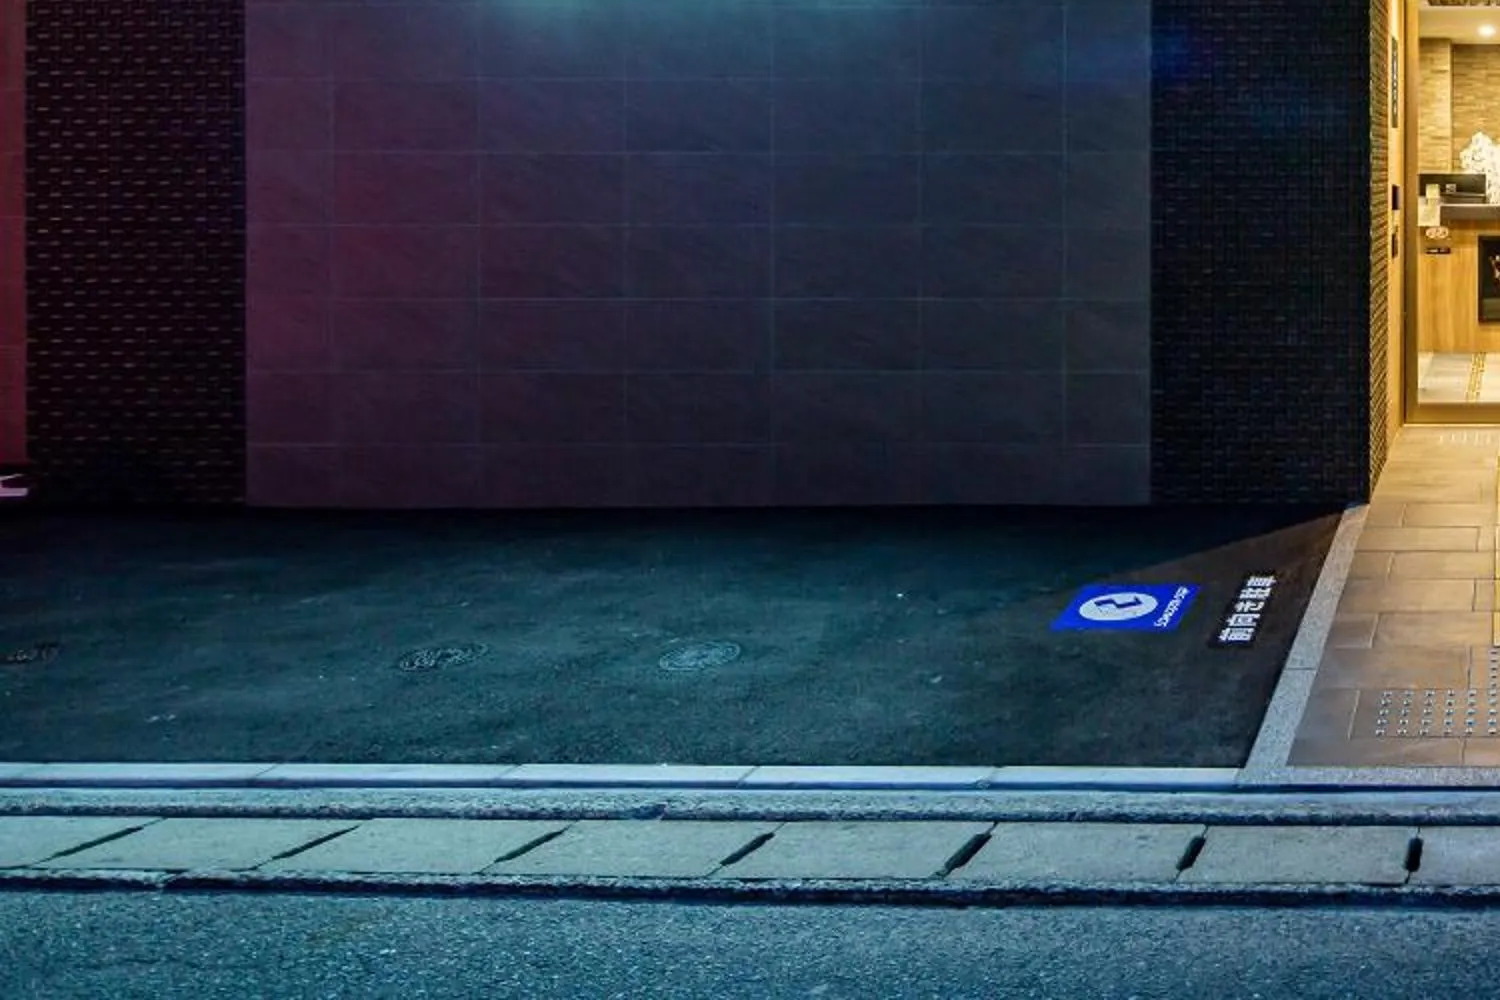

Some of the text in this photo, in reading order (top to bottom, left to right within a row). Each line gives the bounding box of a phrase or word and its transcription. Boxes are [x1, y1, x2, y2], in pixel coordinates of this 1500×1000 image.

[1219, 576, 1277, 641] 前向き駐車
